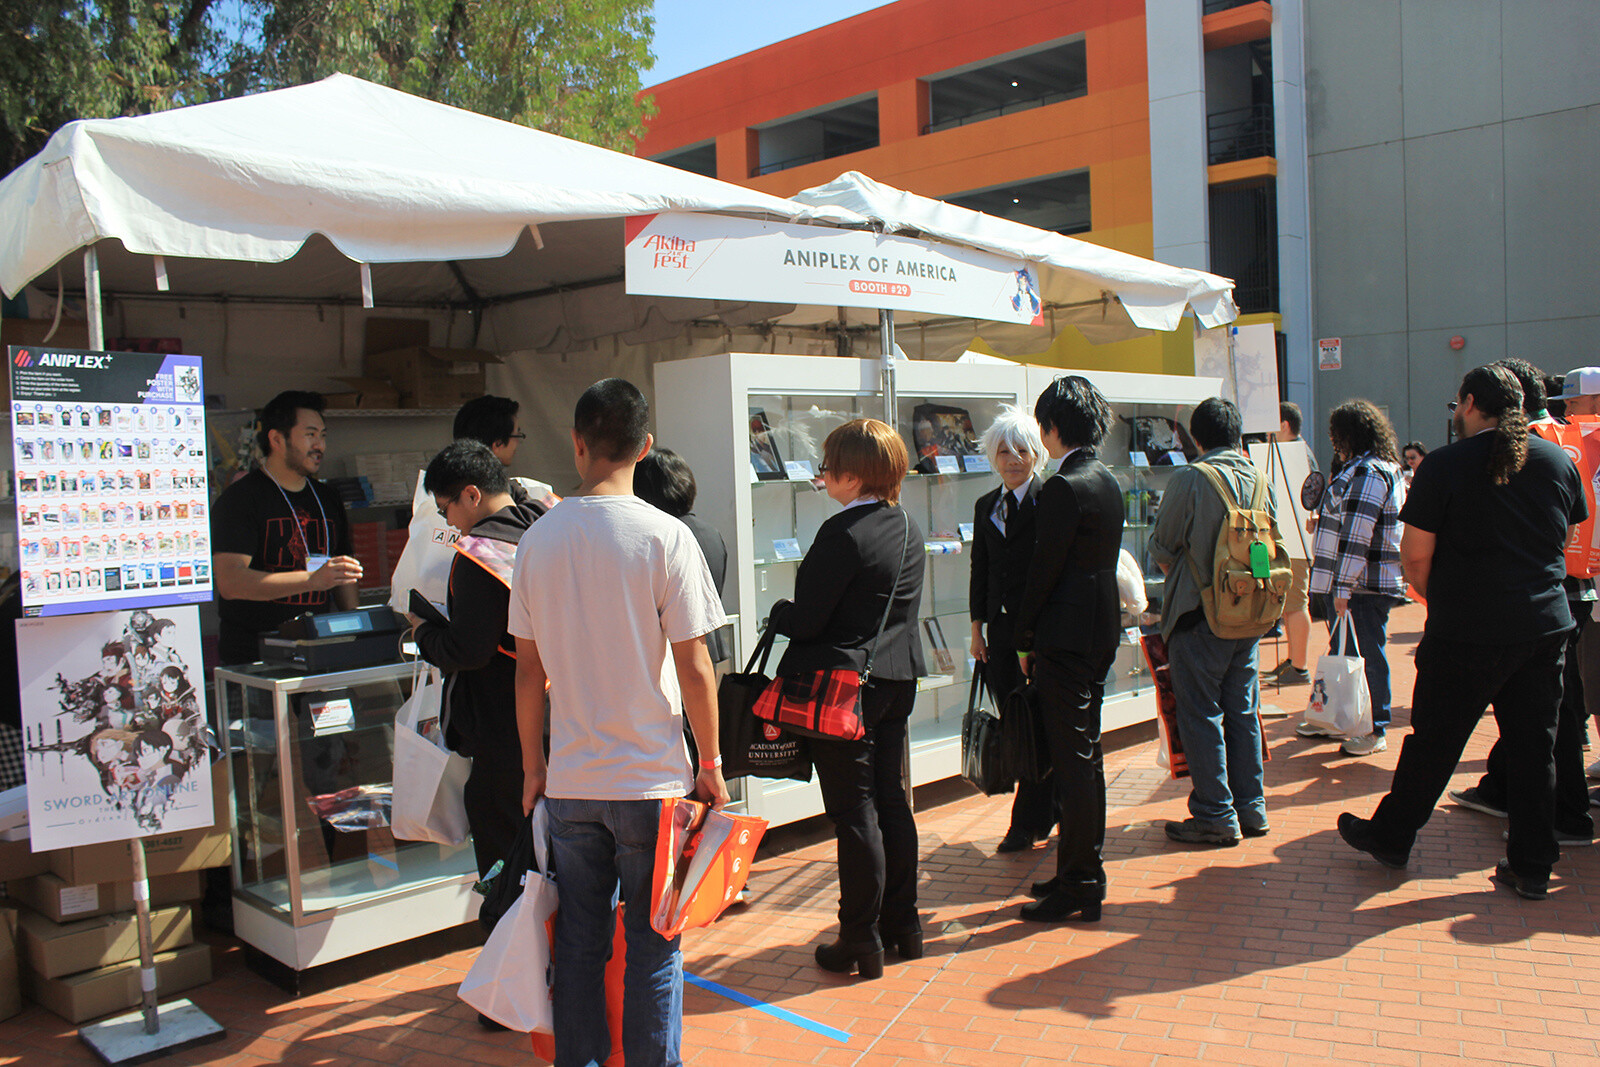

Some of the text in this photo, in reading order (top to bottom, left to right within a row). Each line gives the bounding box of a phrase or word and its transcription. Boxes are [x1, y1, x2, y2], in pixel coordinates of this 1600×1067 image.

[643, 234, 696, 252] Akiba
[653, 252, 693, 269] Fest
[783, 249, 957, 282] ANIPLEX OF AMERICA
[854, 281, 908, 296] BOOTH #29
[137, 391, 173, 399] PURCHASE
[748, 750, 795, 759] UNIVERSITY
[44, 794, 102, 812] SWORD
[110, 790, 136, 802] ART
[145, 781, 199, 798] ONLINE
